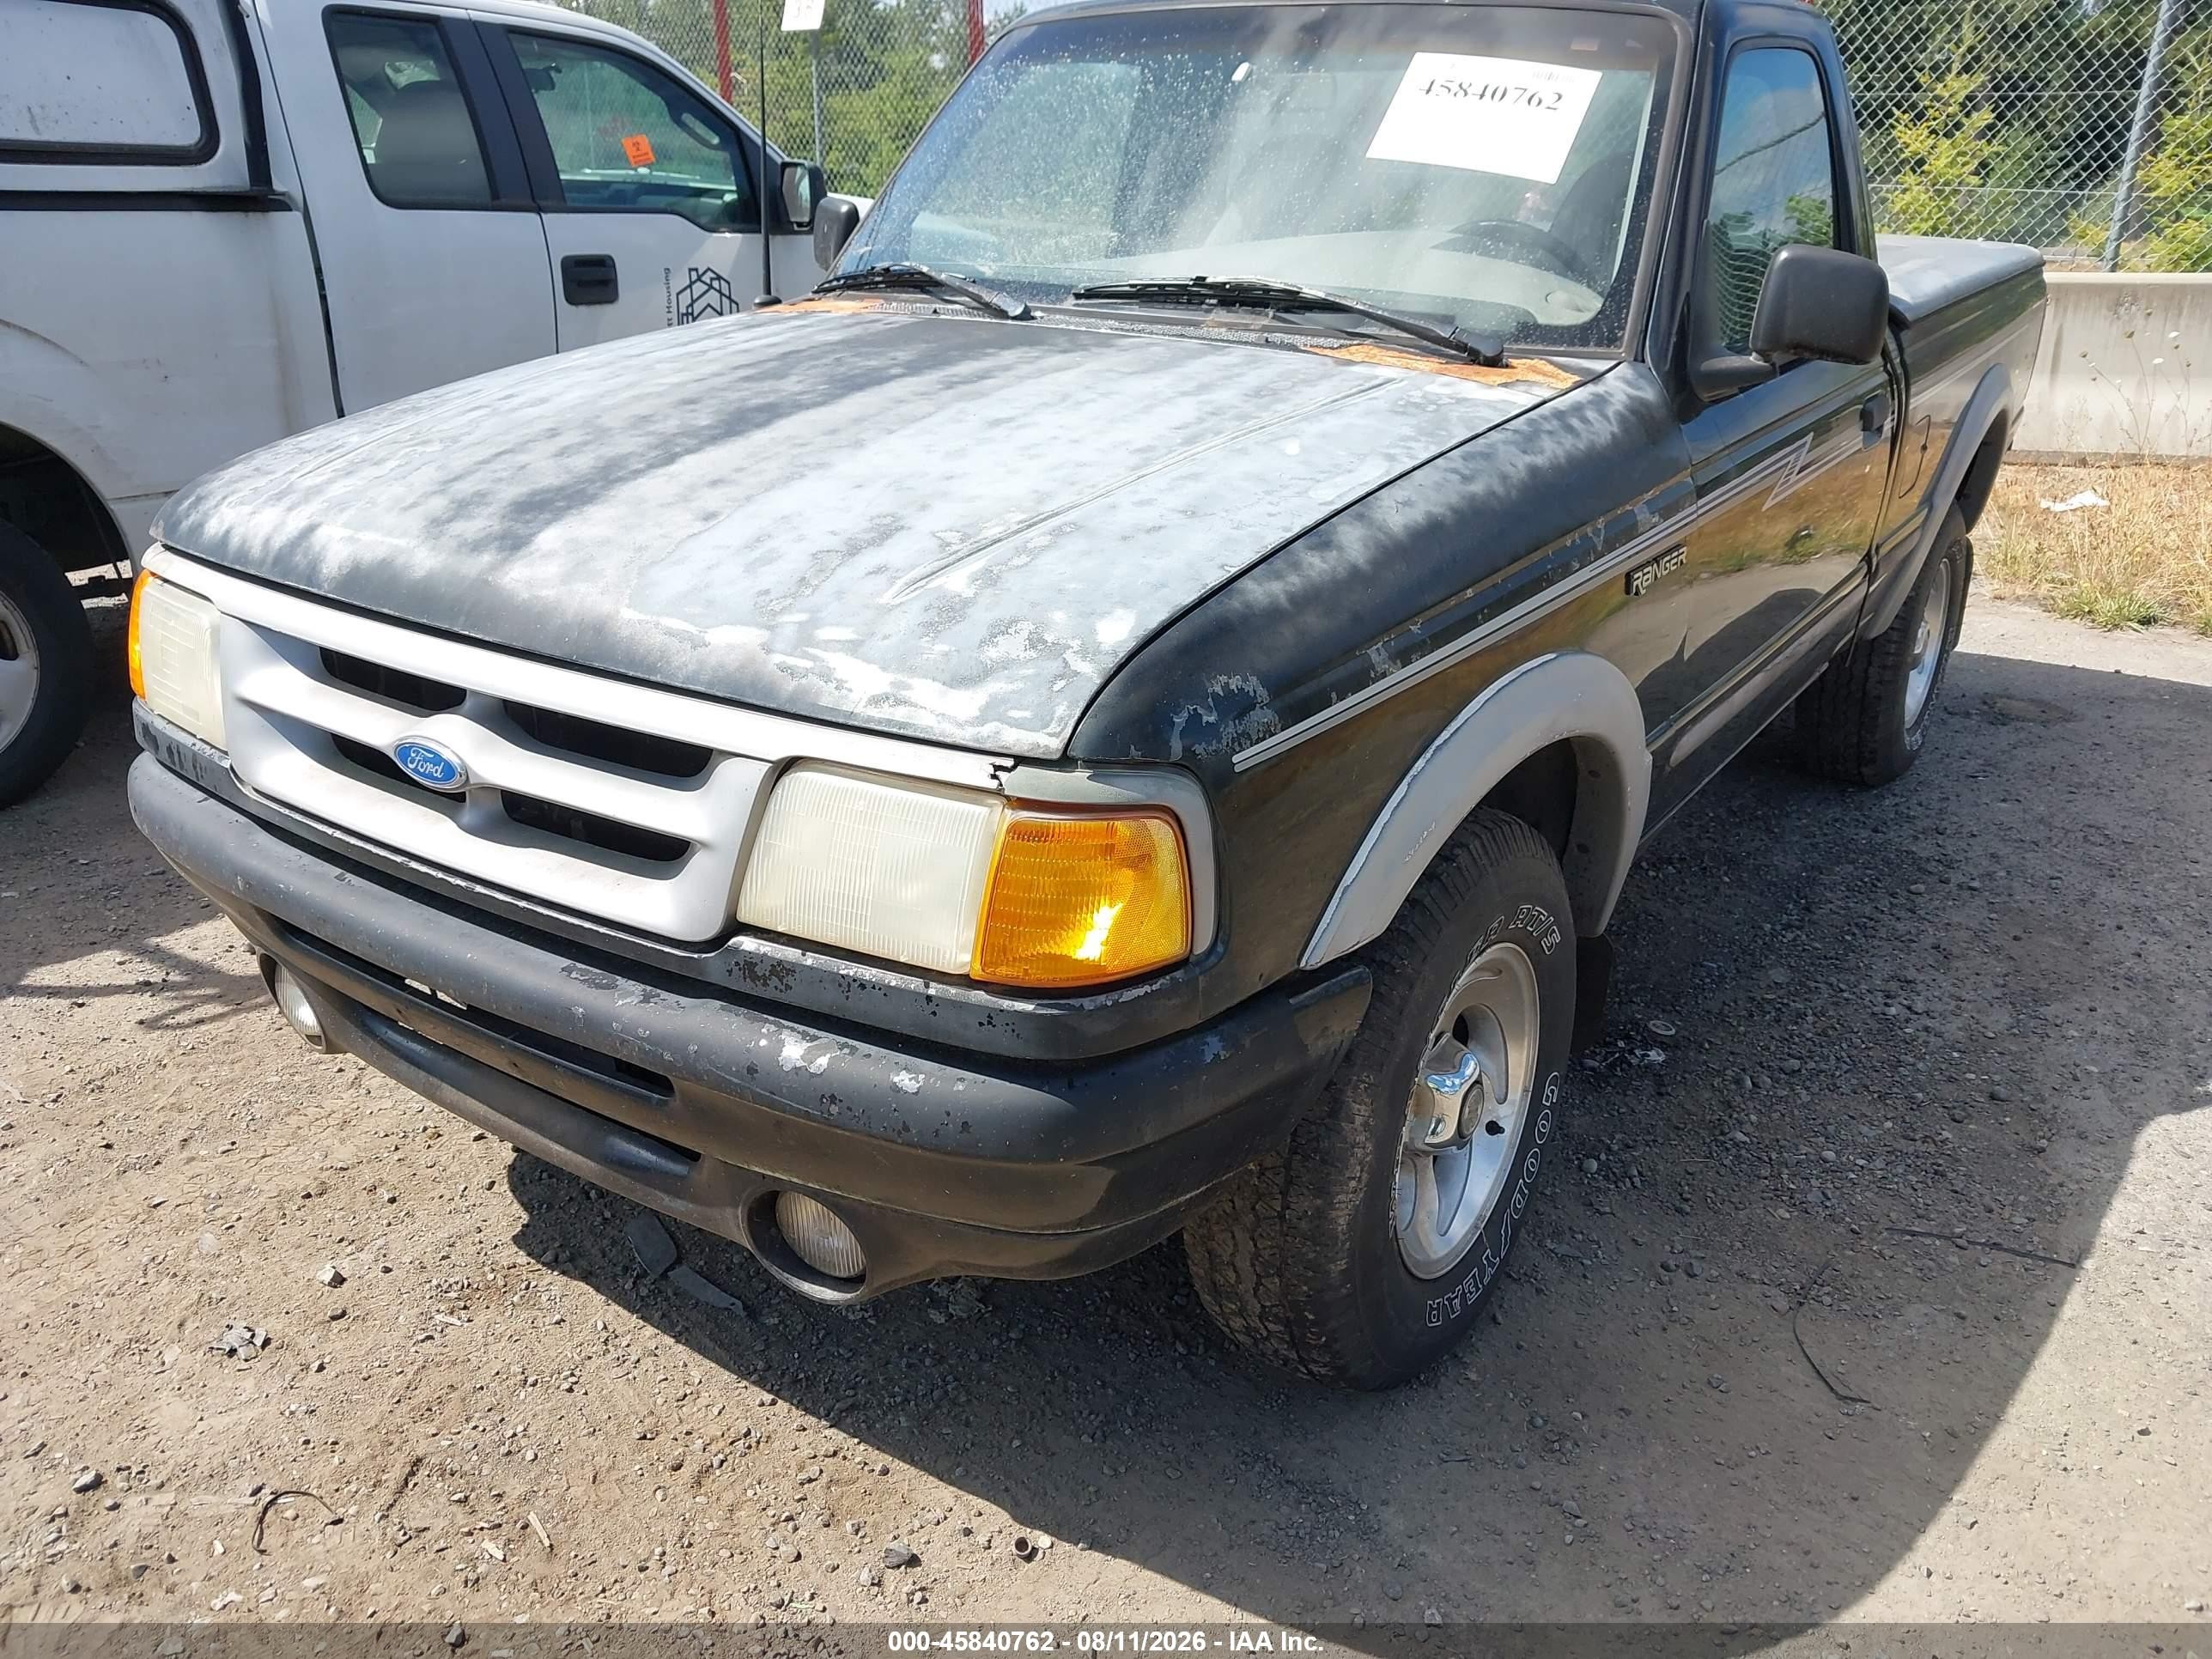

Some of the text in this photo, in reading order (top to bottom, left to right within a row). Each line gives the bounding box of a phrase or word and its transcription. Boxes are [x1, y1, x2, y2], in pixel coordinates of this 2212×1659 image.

[1419, 78, 1563, 111] 45840762
[664, 267, 672, 313] Housing
[1632, 546, 1687, 595] RANGER
[407, 747, 445, 779] Ford
[1508, 904, 1561, 955] AT/S
